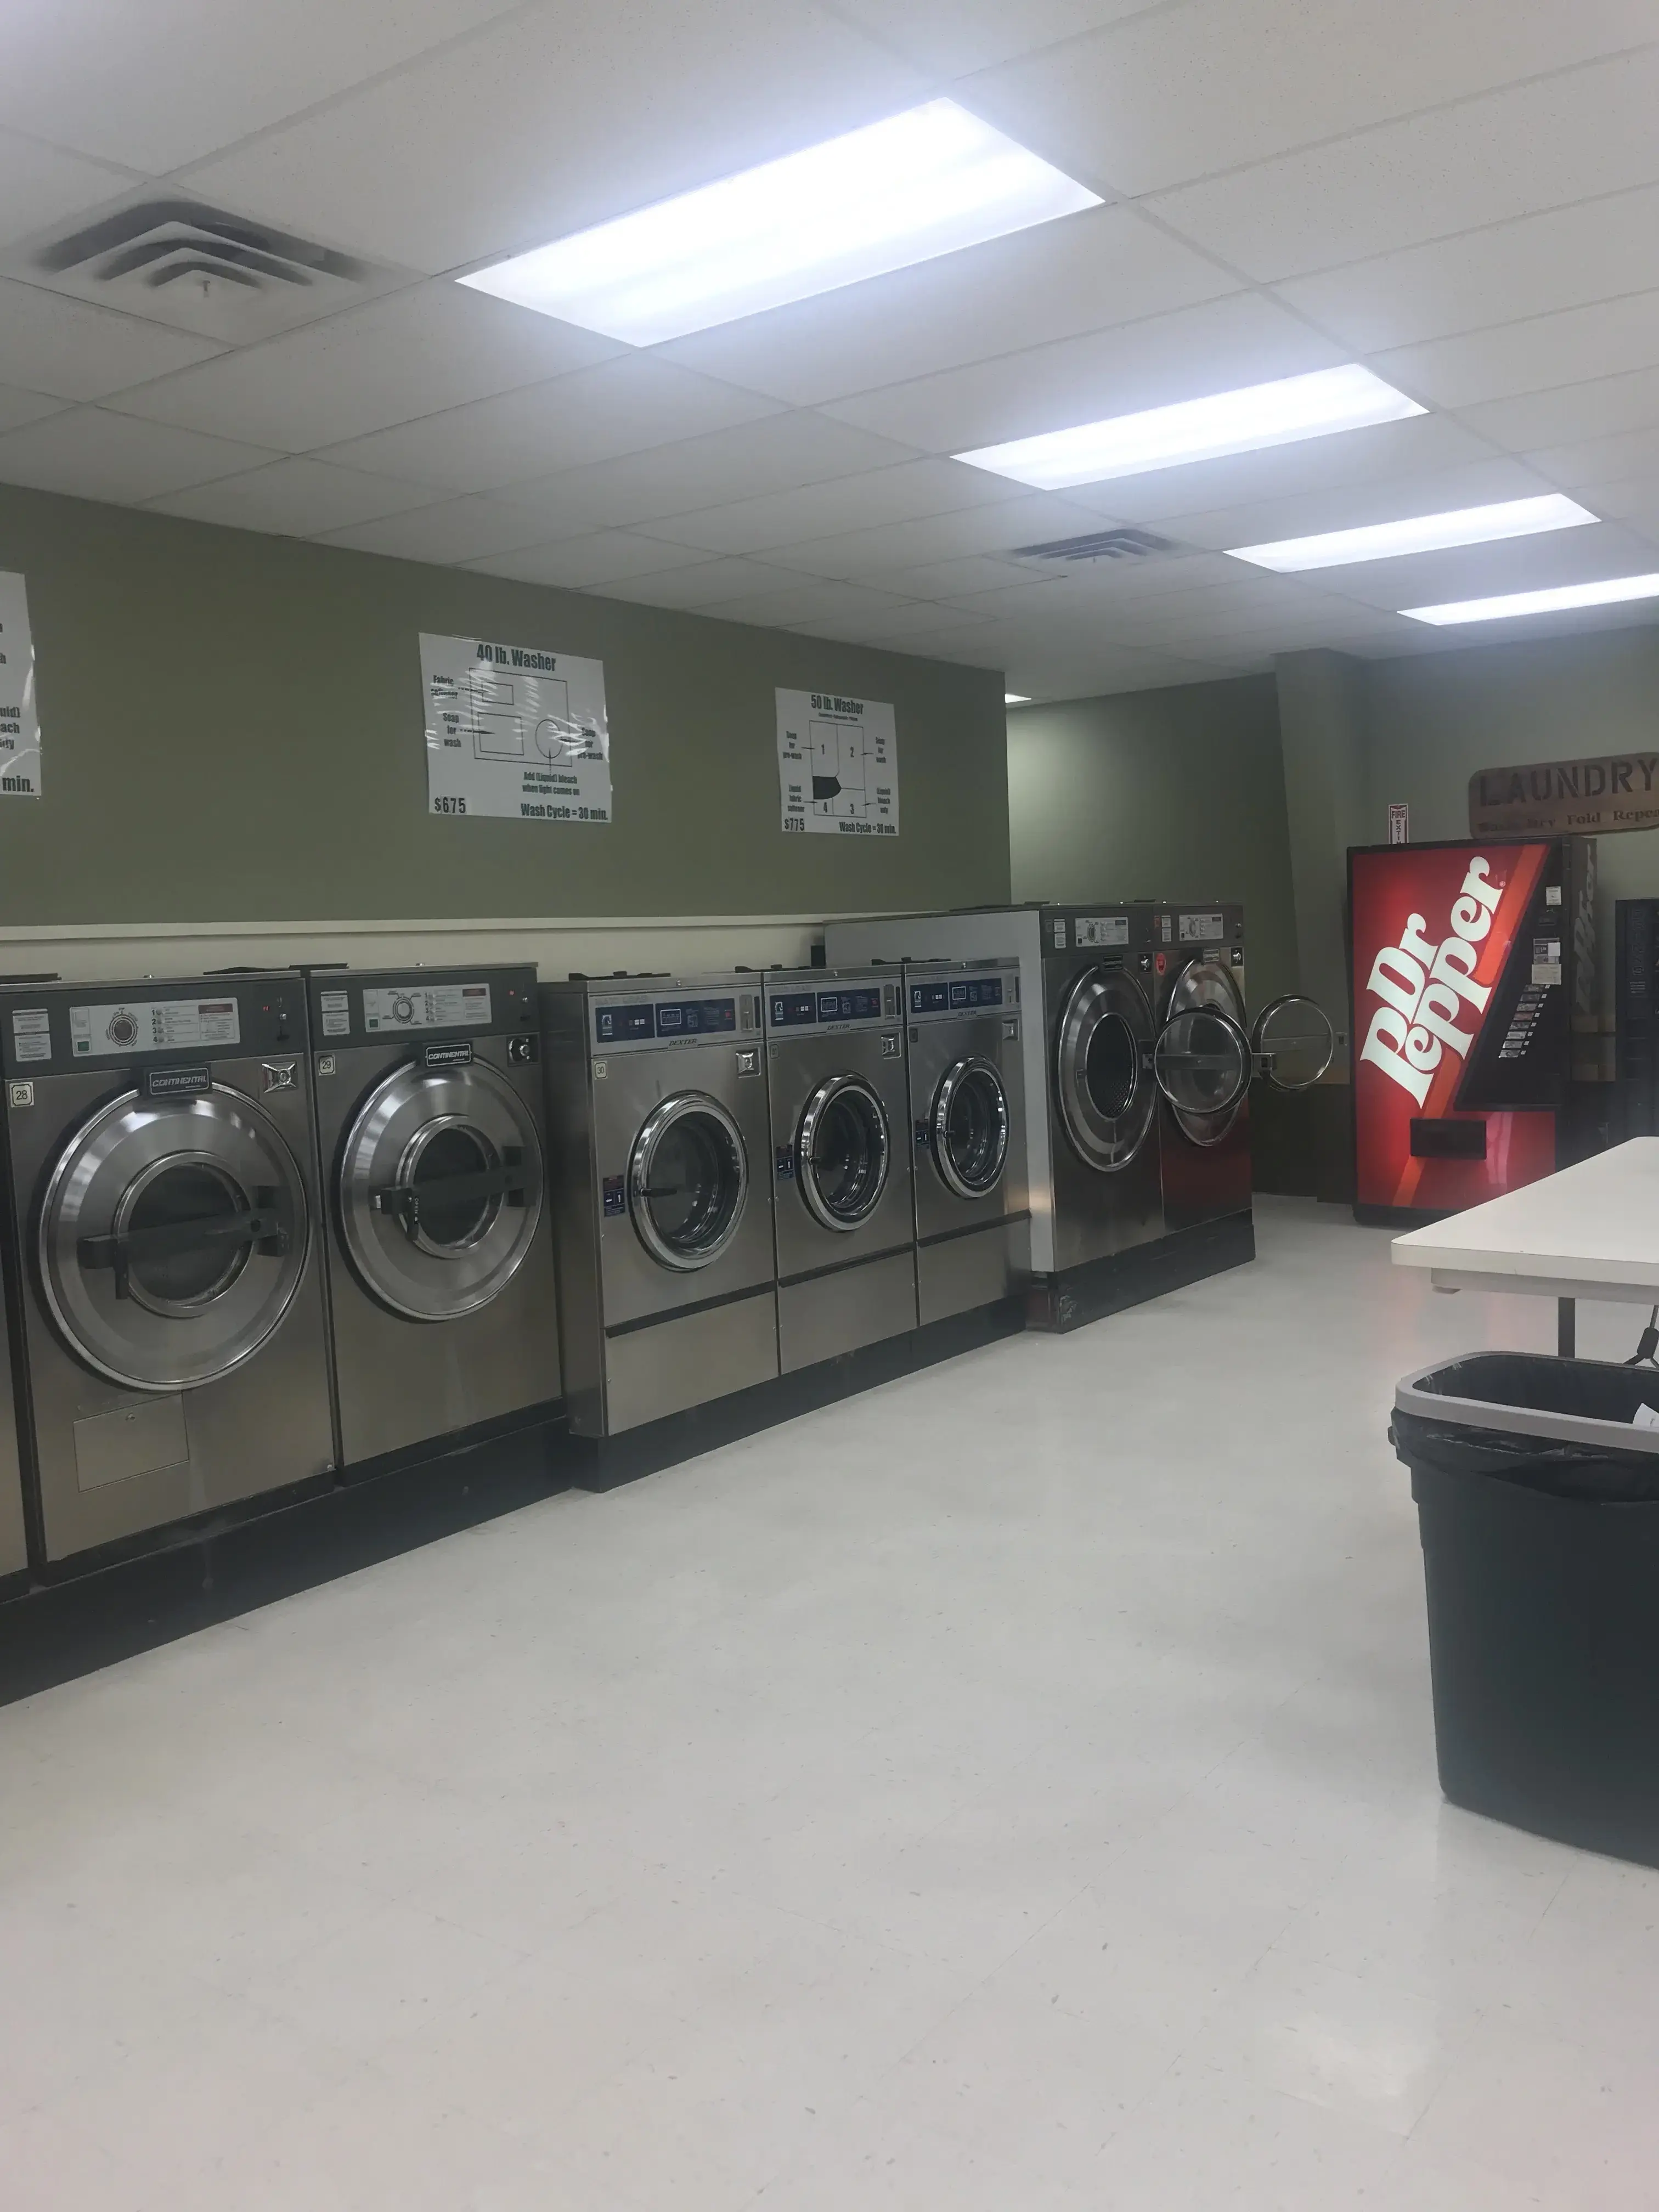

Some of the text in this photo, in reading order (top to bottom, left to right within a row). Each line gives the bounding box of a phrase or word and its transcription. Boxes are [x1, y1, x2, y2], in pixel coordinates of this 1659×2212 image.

[477, 644, 556, 671] 40 lb. Washer
[811, 695, 864, 715] 50 lb. Washer
[444, 738, 461, 747] wash
[821, 744, 825, 755] 1
[850, 747, 855, 758] 2
[2, 776, 34, 792] min.
[1480, 758, 1658, 807] LAUNDRY
[434, 797, 466, 814] $675
[521, 803, 545, 816] Wash
[547, 804, 571, 819] Cycle
[578, 806, 589, 819] 30
[590, 808, 608, 820] min.
[823, 802, 827, 813] 4
[850, 803, 855, 814] 3
[1392, 810, 1406, 819] FIRE
[1567, 812, 1600, 825] Fold
[785, 818, 805, 831] $775
[839, 821, 855, 832] Wash
[856, 822, 871, 834] Cycle
[877, 823, 883, 833] 30
[884, 824, 896, 834] min.
[1366, 913, 1439, 1025] Dr
[1359, 856, 1504, 1109] Pepper
[669, 1038, 697, 1046] DEXTER
[428, 1050, 470, 1060] CONTINENTAL
[322, 1060, 331, 1070] 29
[152, 1075, 208, 1088] CONTINENTAL
[16, 1089, 28, 1101] 28
